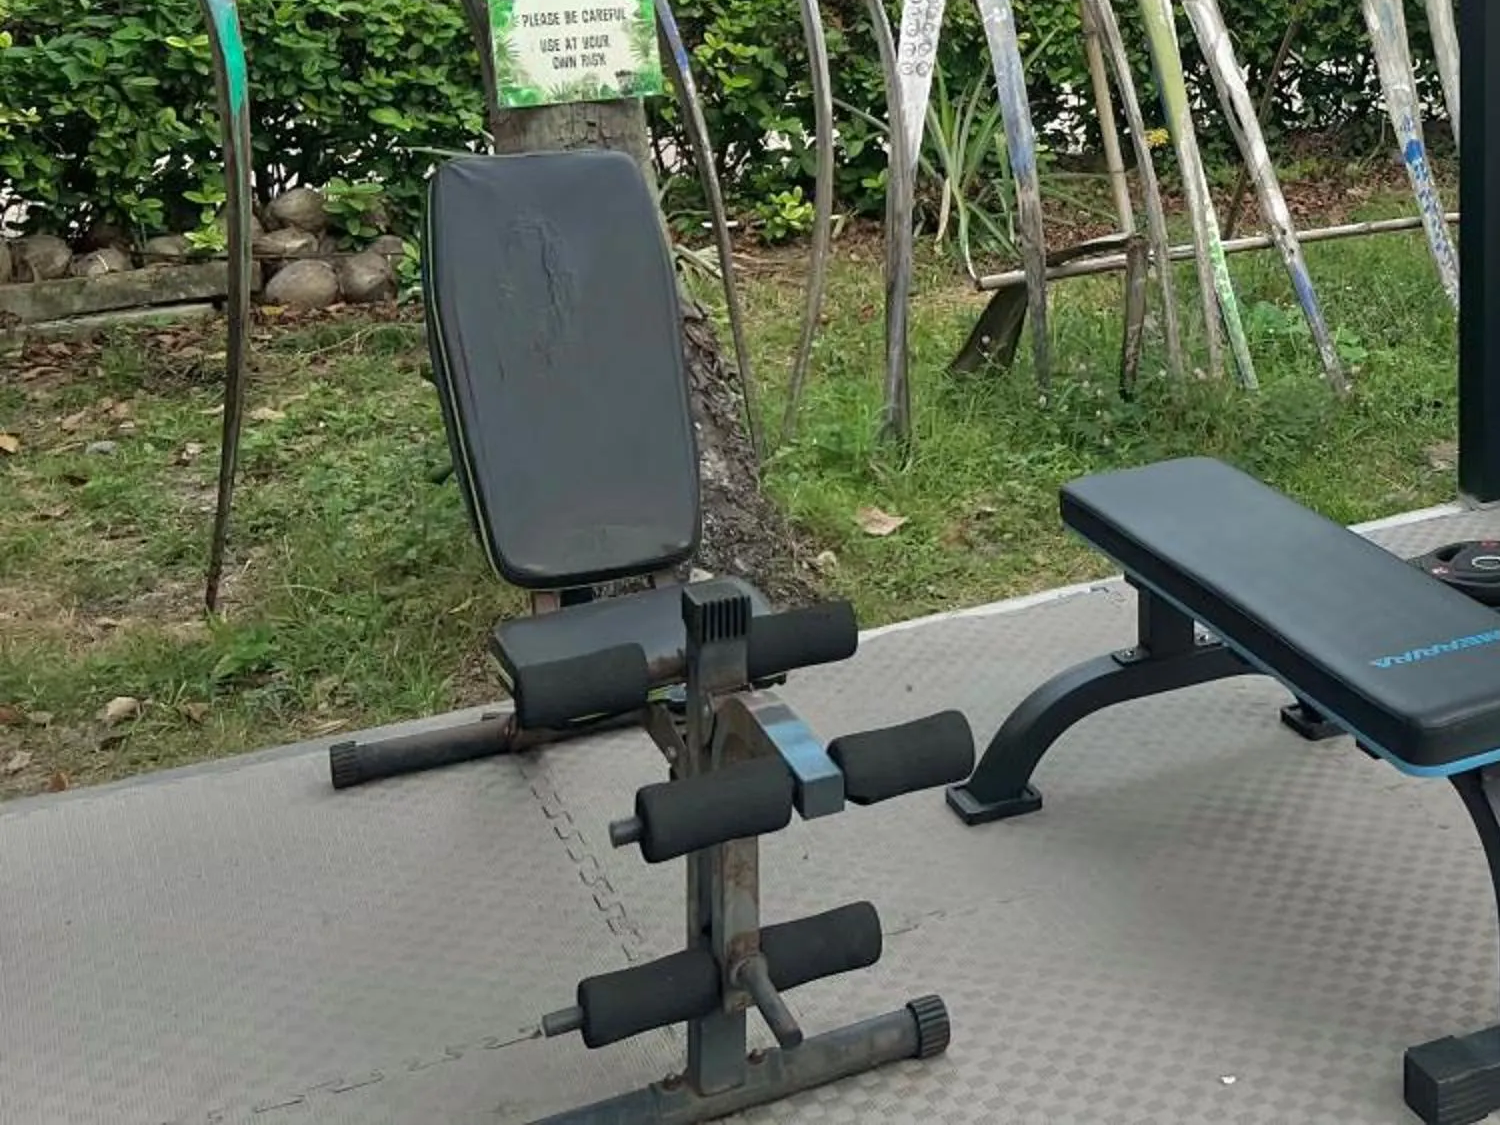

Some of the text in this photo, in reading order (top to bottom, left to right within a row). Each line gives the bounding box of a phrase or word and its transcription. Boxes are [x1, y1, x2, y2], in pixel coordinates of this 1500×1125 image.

[522, 7, 627, 27] PLEASE BE CAREFUL
[540, 35, 609, 53] USE AT YOUR
[552, 53, 606, 70] OWN RISK
